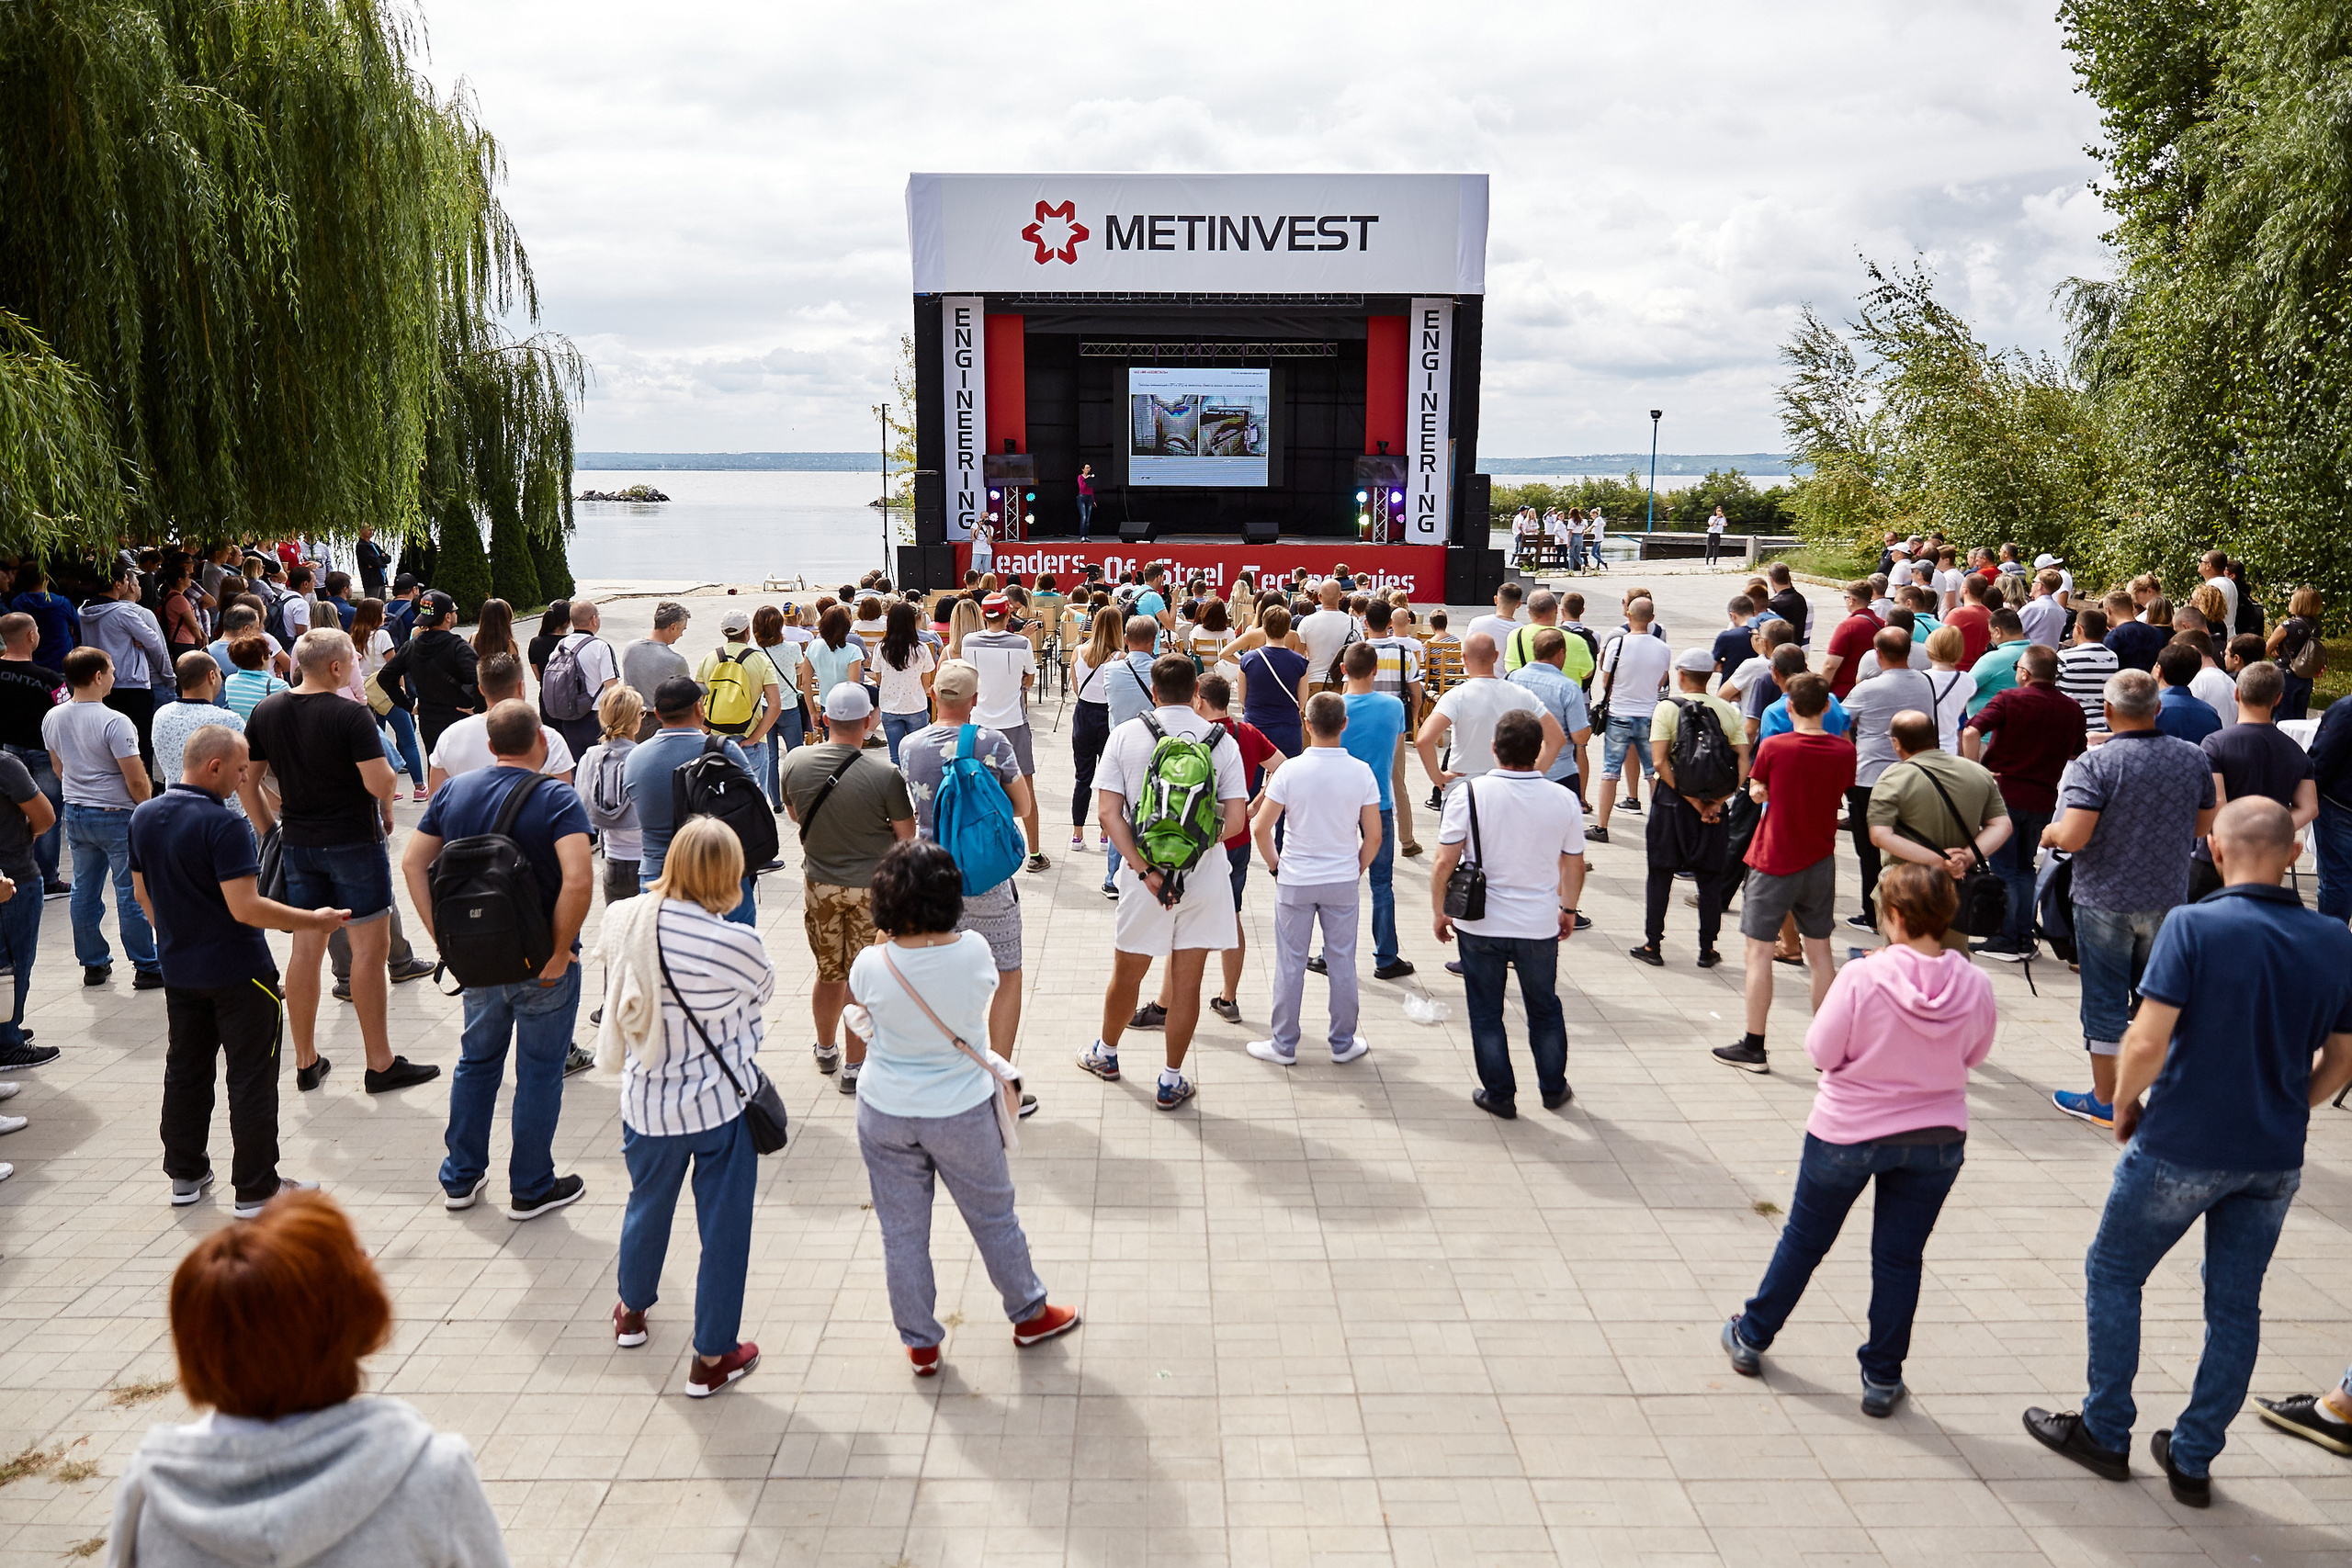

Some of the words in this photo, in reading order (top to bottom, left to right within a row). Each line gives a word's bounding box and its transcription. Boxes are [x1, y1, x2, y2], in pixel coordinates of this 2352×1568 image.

[1106, 214, 1379, 252] METINVEST
[955, 308, 975, 530] ENGINEERING
[1418, 310, 1440, 534] ENGINEERING
[979, 550, 1085, 574] eaders
[1104, 557, 1136, 584] Of
[469, 908, 482, 919] CAT
